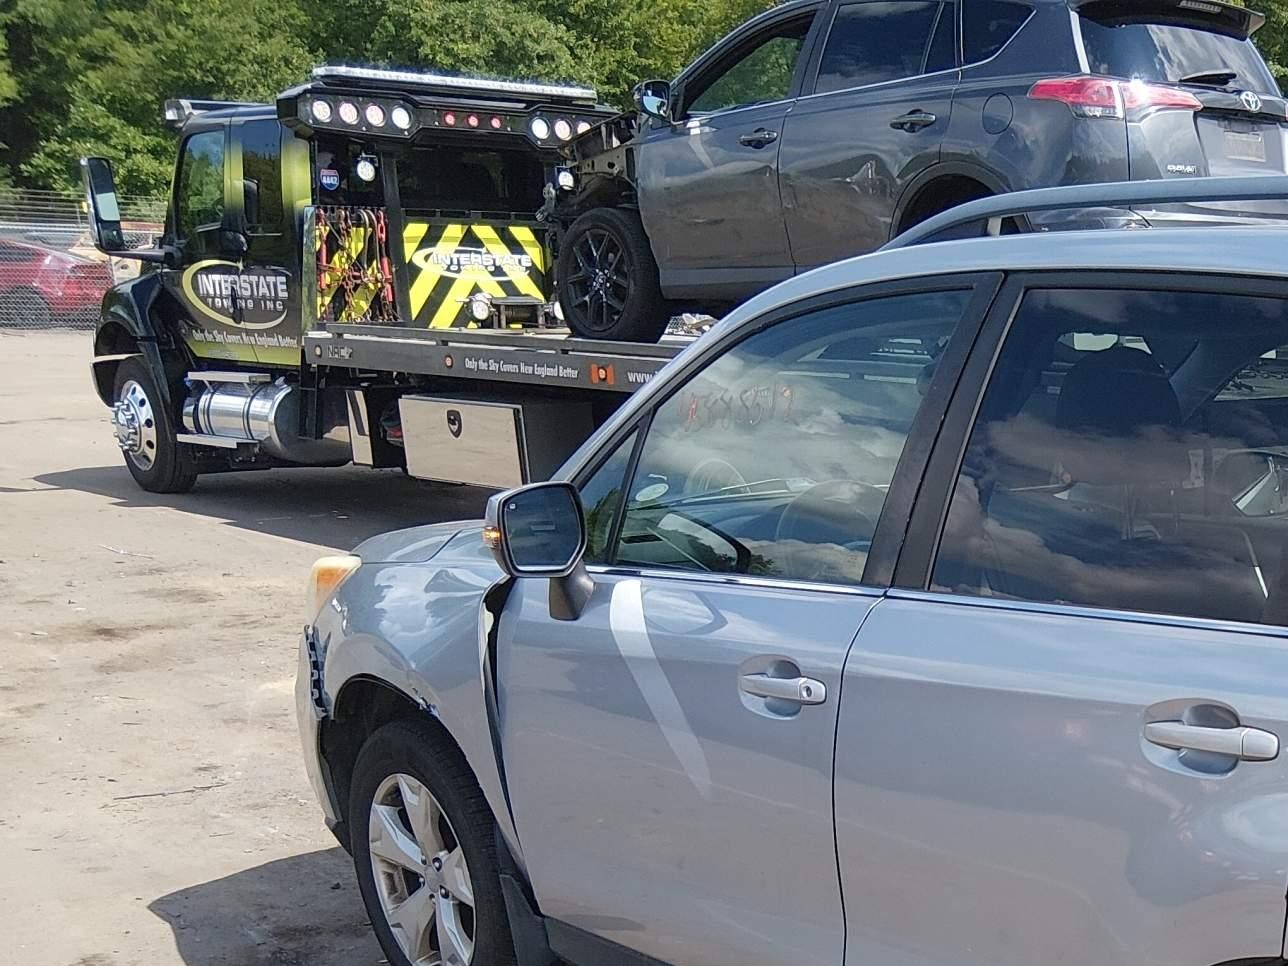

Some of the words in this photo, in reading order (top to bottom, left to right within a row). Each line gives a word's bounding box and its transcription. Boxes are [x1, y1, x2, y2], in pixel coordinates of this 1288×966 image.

[432, 252, 533, 267] INTERSTATE
[198, 274, 289, 299] INTERSTATE
[207, 297, 254, 313] TOWNG
[260, 300, 284, 312] INC
[465, 357, 478, 371] Only
[479, 358, 488, 370] the
[489, 359, 499, 373] Sky
[500, 360, 519, 373] Covers
[520, 362, 533, 374] New
[535, 363, 558, 378] England
[559, 366, 578, 378] Better
